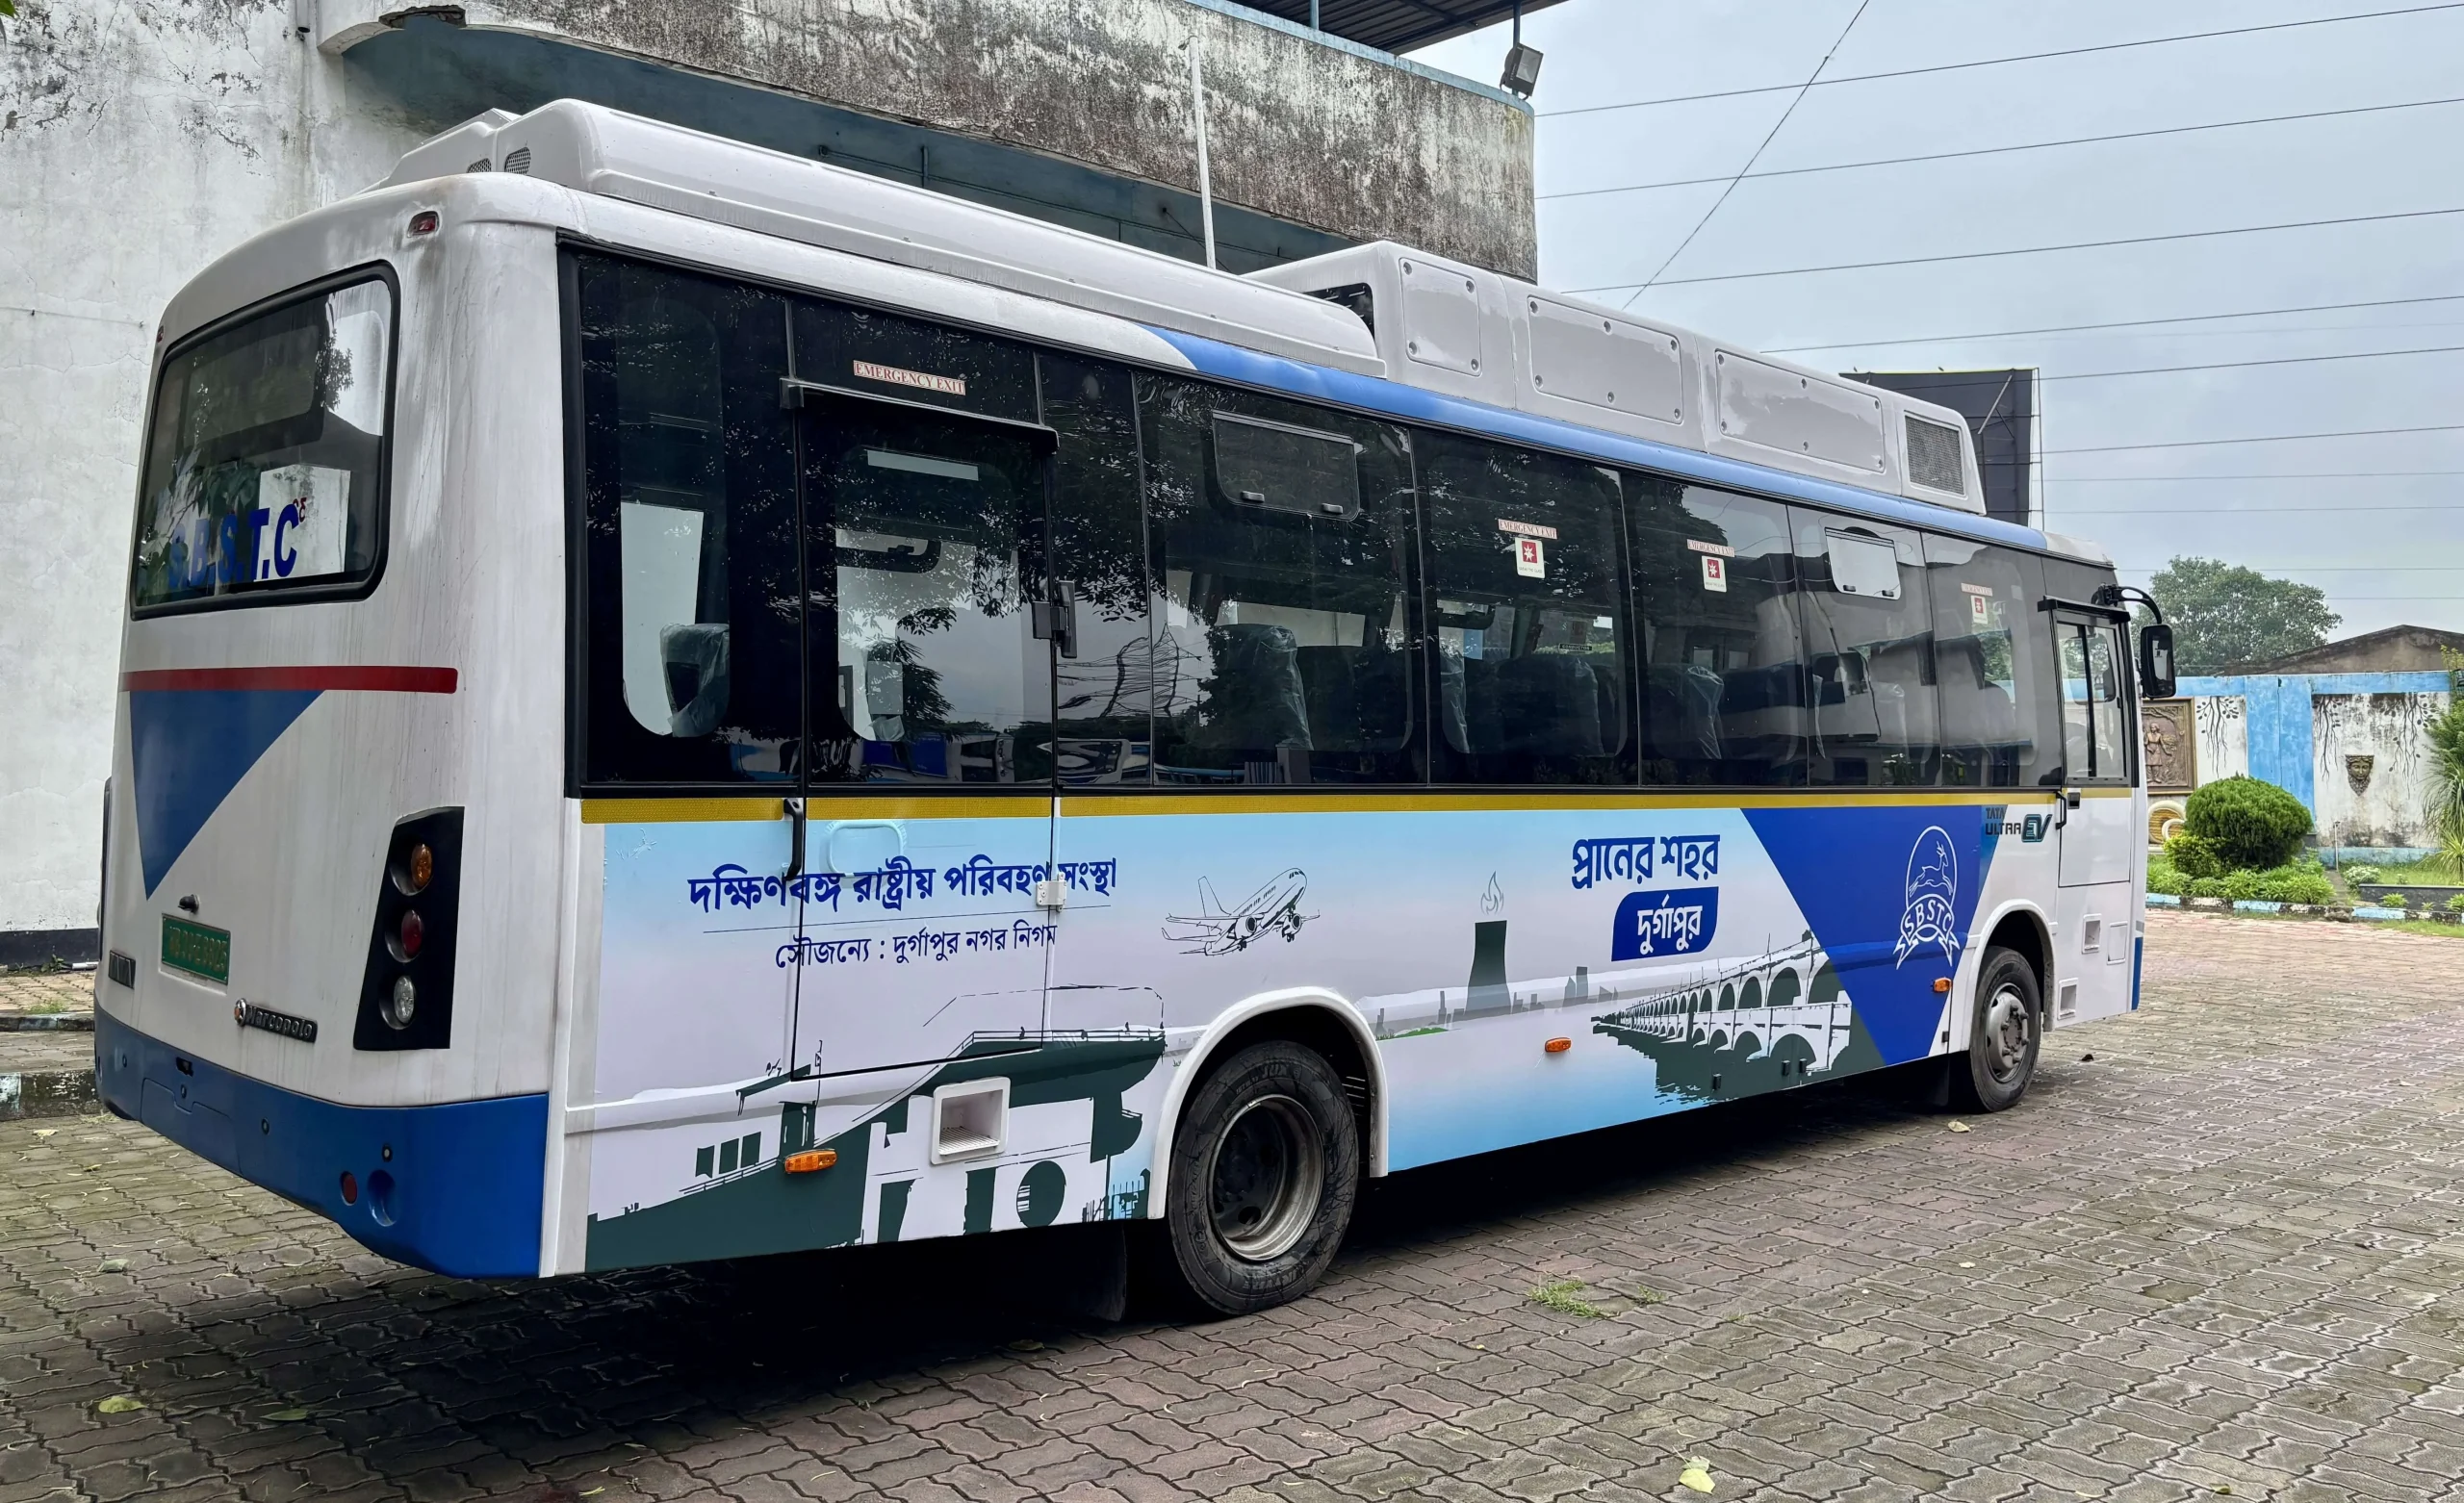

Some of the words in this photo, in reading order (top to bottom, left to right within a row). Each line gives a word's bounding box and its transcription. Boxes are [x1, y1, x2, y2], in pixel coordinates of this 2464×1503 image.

[856, 362, 934, 388] EMERGENCY
[937, 378, 964, 394] EXIT
[1500, 521, 1540, 535] EMERGENCY
[1541, 527, 1556, 538] EXIT
[1985, 822, 2021, 835] ULTRA
[1572, 836, 1655, 890] প্রানের
[1660, 834, 1721, 881] শহর
[687, 863, 845, 913] দক্ষিণবঙ্গ
[853, 855, 937, 911] রাষ্ট্রীয়
[1058, 857, 1116, 897] সংস্থা
[1637, 893, 1703, 955] দুর্গাপুর
[1904, 899, 1952, 937] SBSTC
[776, 934, 871, 968] সৌজন্যে
[892, 927, 961, 963] দুর্গাপুর
[965, 928, 1009, 952] নগর
[1013, 919, 1058, 950] নিগম
[246, 1005, 313, 1039] Marcopolo
